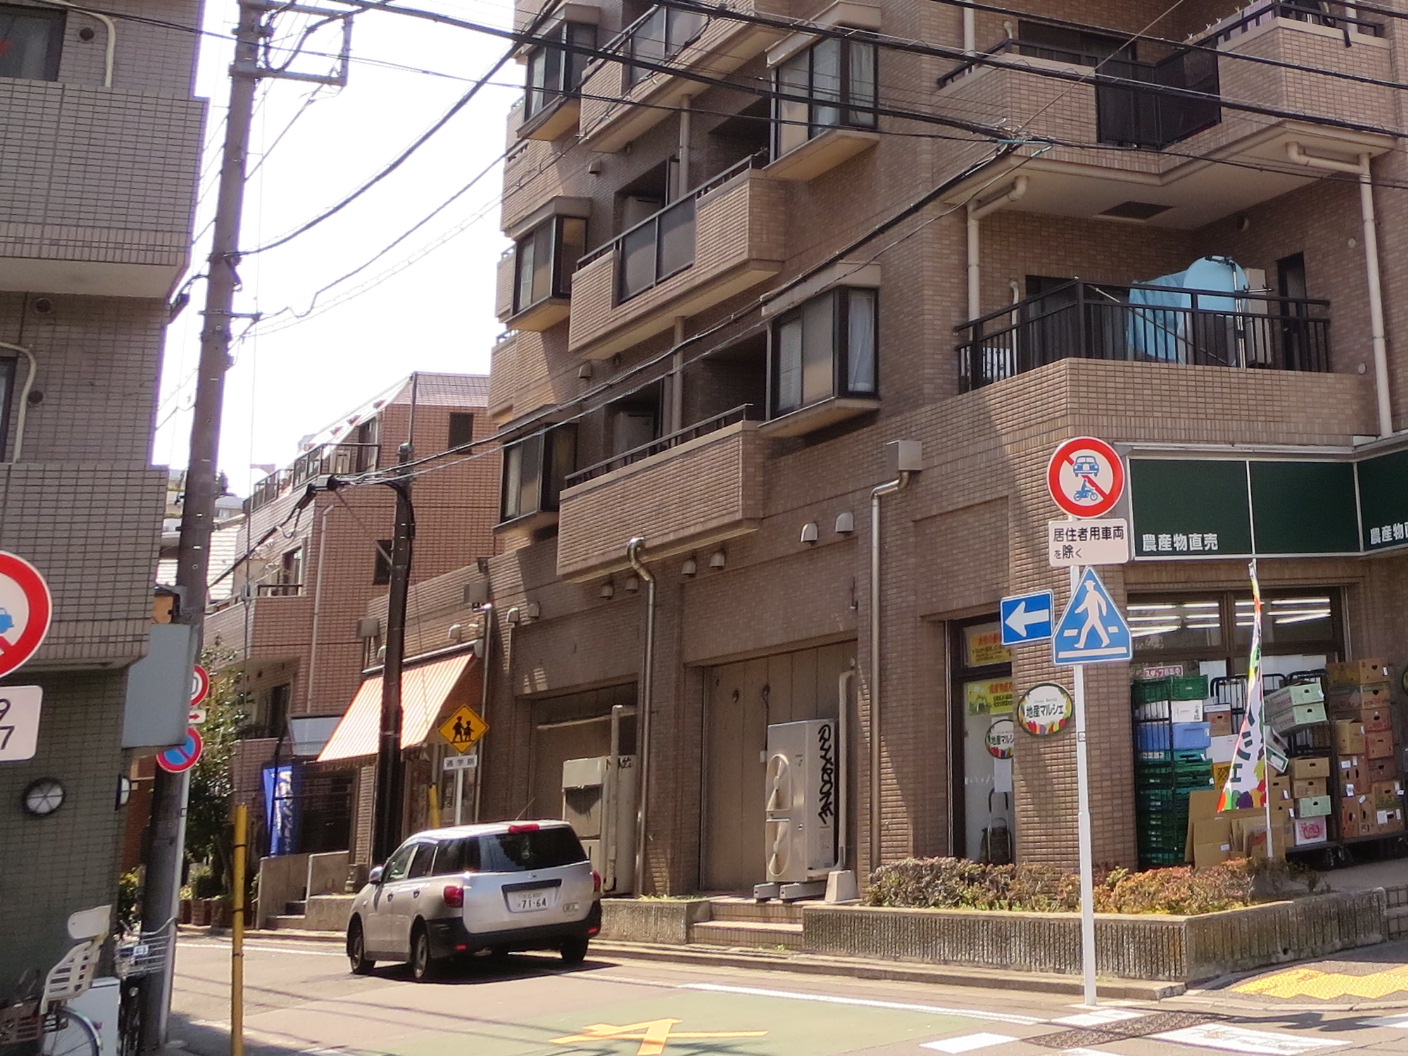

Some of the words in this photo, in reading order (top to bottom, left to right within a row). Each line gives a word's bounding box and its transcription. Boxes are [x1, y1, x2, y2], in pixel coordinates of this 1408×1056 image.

[1053, 525, 1124, 542] 居住者用車両
[1142, 533, 1218, 552] 農産物直売
[1054, 544, 1083, 560] を除く
[1026, 704, 1064, 718] 地産マルシェ
